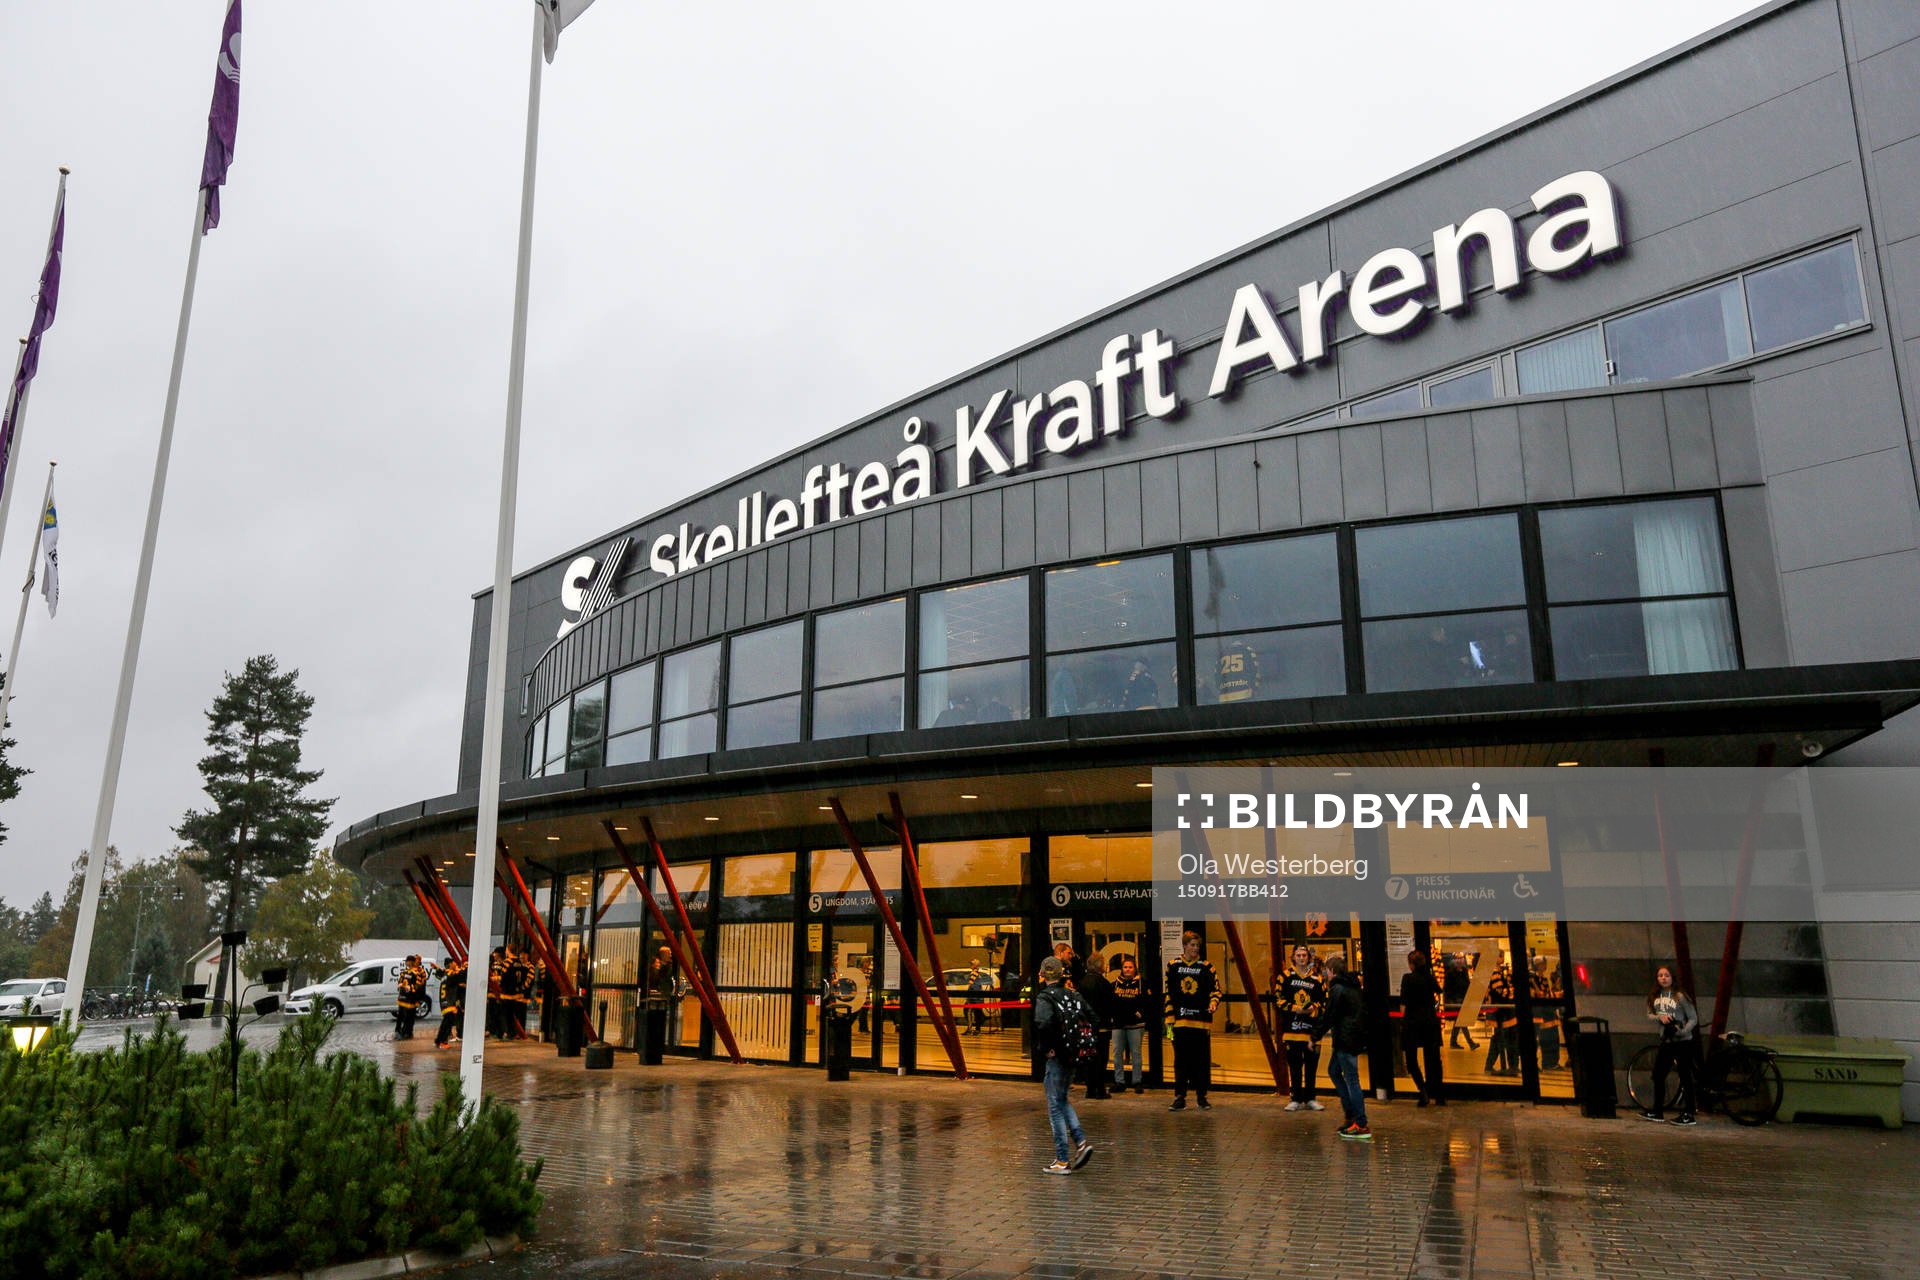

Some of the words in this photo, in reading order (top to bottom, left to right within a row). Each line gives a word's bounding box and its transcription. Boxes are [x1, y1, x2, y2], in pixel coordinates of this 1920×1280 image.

[650, 416, 932, 577] Skellefteå
[956, 328, 1176, 488] Kraft
[1207, 170, 1624, 398] Arena
[1220, 653, 1244, 675] 25
[1416, 875, 1451, 887] PRESS
[1074, 889, 1111, 901] VUXEN,
[1112, 887, 1159, 900] STÅPLATS
[1416, 886, 1496, 901] FUNKTIONÄR
[825, 897, 859, 908] UNGDOM,
[834, 942, 868, 1014] 5
[1813, 1067, 1858, 1081] SAND
